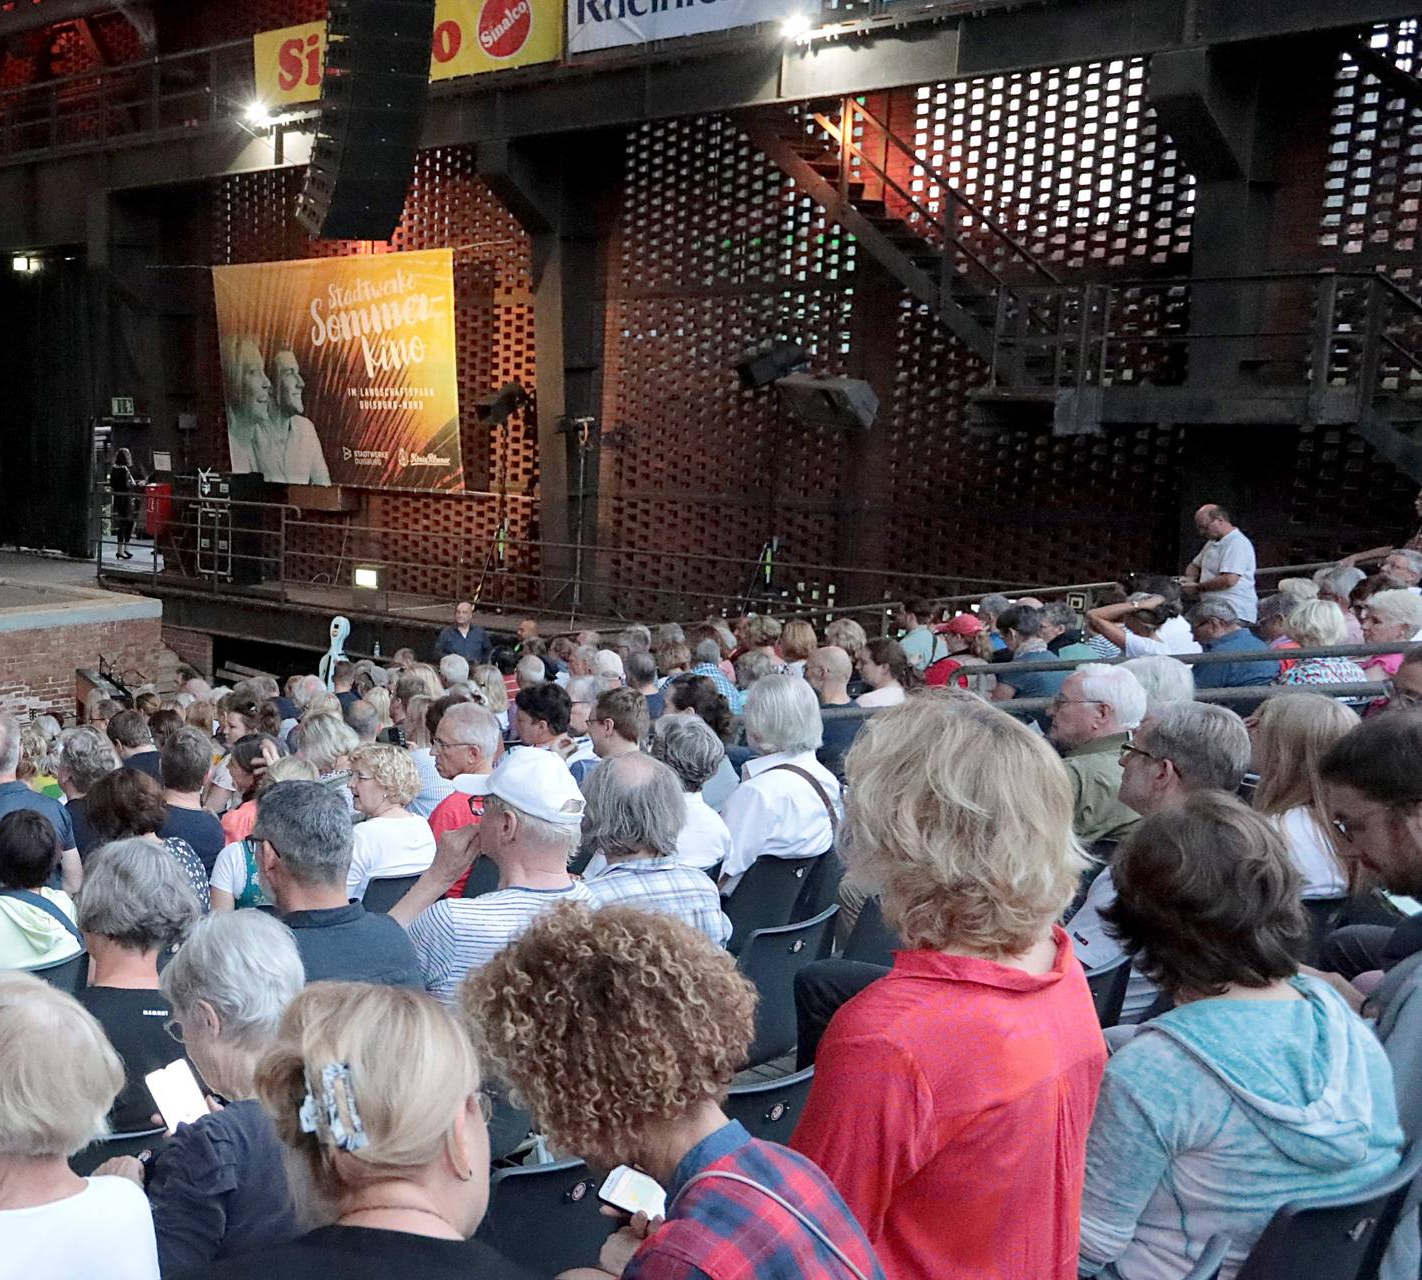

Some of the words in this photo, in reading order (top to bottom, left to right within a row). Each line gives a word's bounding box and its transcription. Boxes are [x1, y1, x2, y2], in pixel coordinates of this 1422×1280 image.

[480, 1, 527, 48] Sinalco
[328, 268, 417, 309] Stadtwerke
[361, 335, 426, 379] kino
[360, 387, 435, 397] LANDSCHAFTSPARK
[353, 450, 389, 459] STADTWERKE
